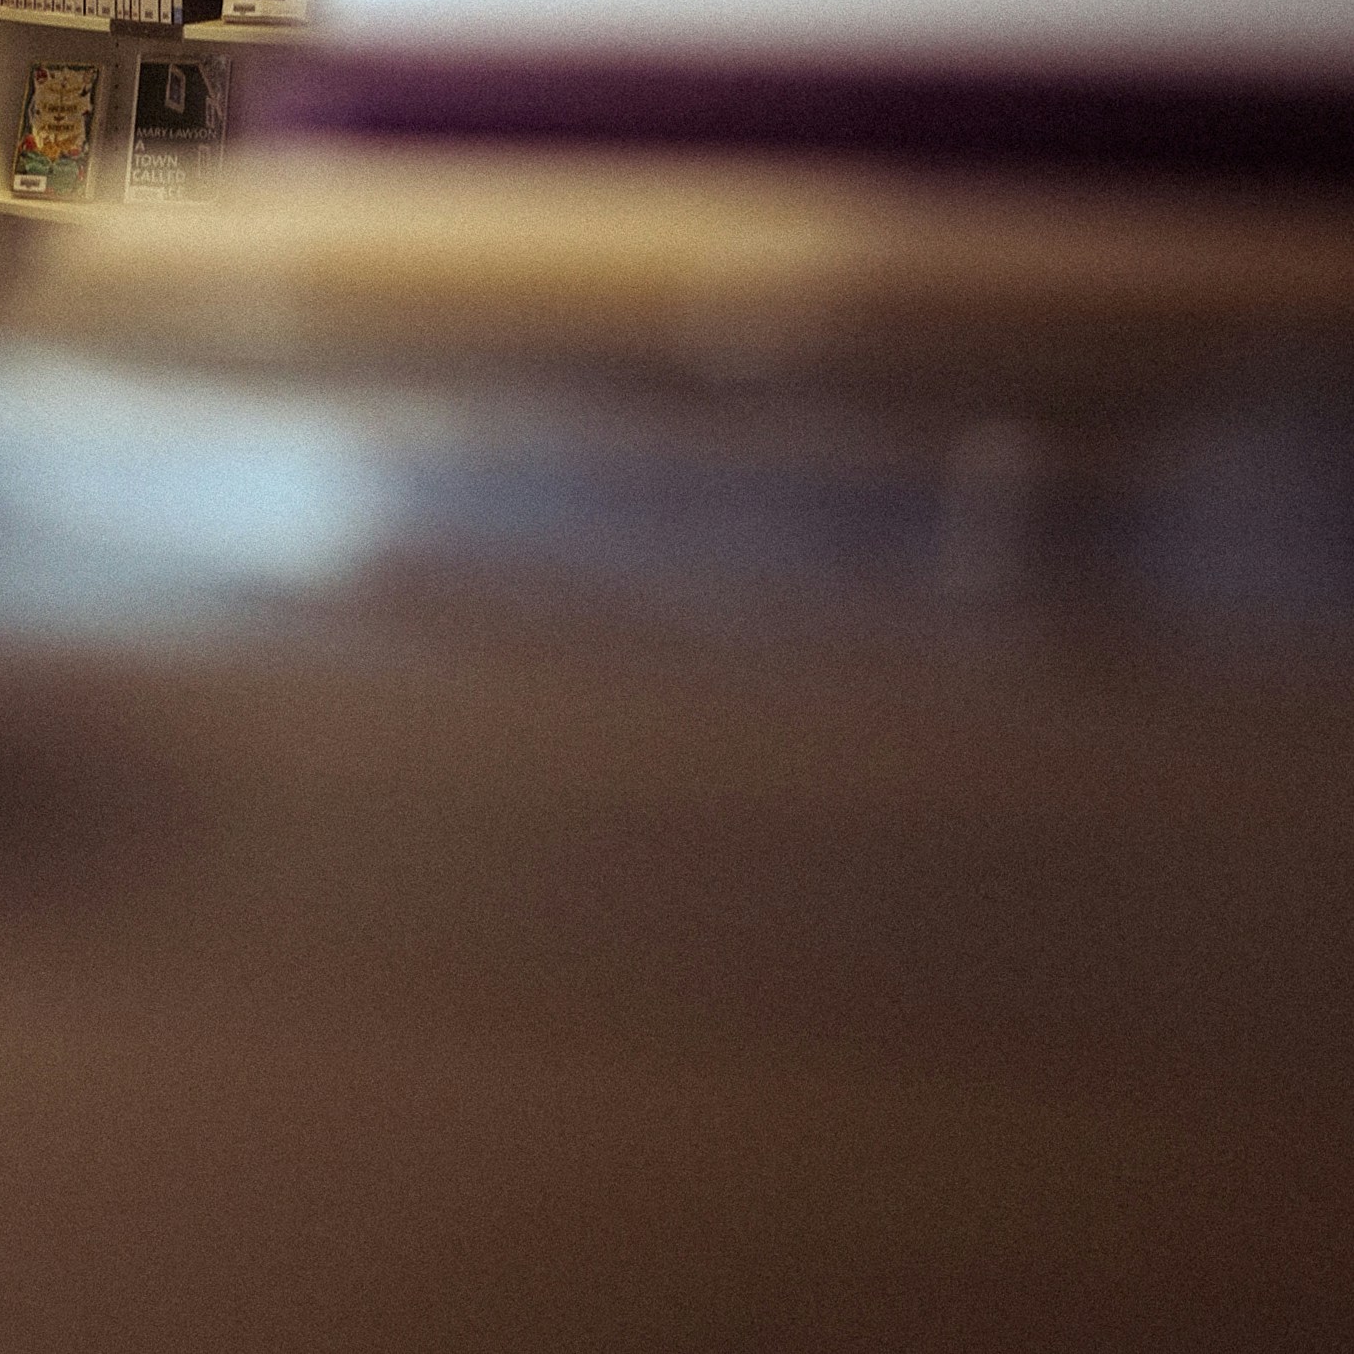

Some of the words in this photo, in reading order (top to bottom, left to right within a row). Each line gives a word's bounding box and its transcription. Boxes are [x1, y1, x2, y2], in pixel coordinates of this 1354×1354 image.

[168, 127, 218, 140] LAWSON
[134, 138, 146, 152] A
[133, 152, 179, 168] TOWN
[132, 168, 187, 184] CALLED
